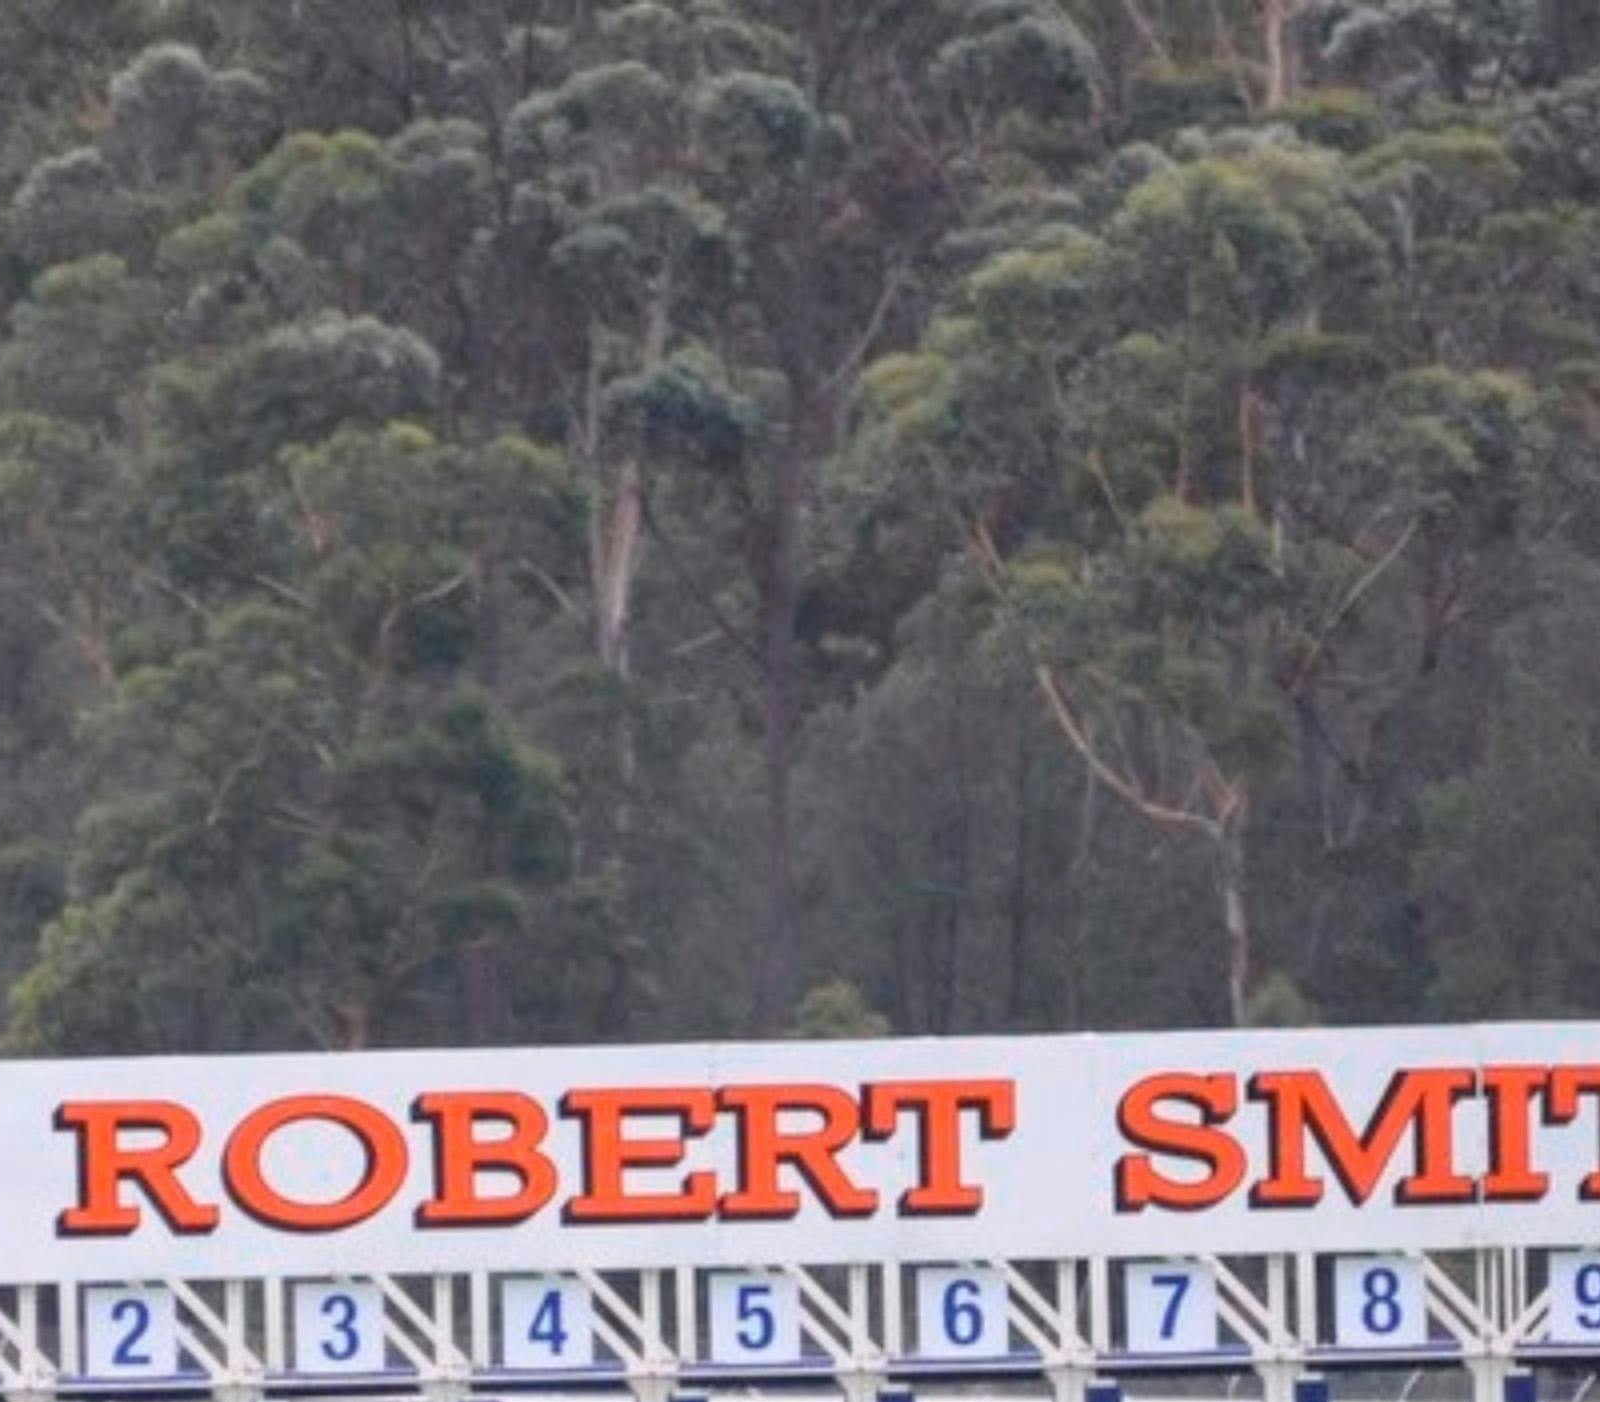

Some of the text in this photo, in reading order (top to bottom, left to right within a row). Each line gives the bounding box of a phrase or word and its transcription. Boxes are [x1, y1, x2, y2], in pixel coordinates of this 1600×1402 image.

[54, 1080, 1015, 1236] ROBERT
[111, 1299, 150, 1365] 2
[321, 1294, 359, 1360] 3
[528, 1289, 567, 1355] 4
[737, 1284, 774, 1350] 5
[943, 1279, 983, 1345] 6
[1151, 1273, 1191, 1339] 7
[1362, 1267, 1401, 1334] 8
